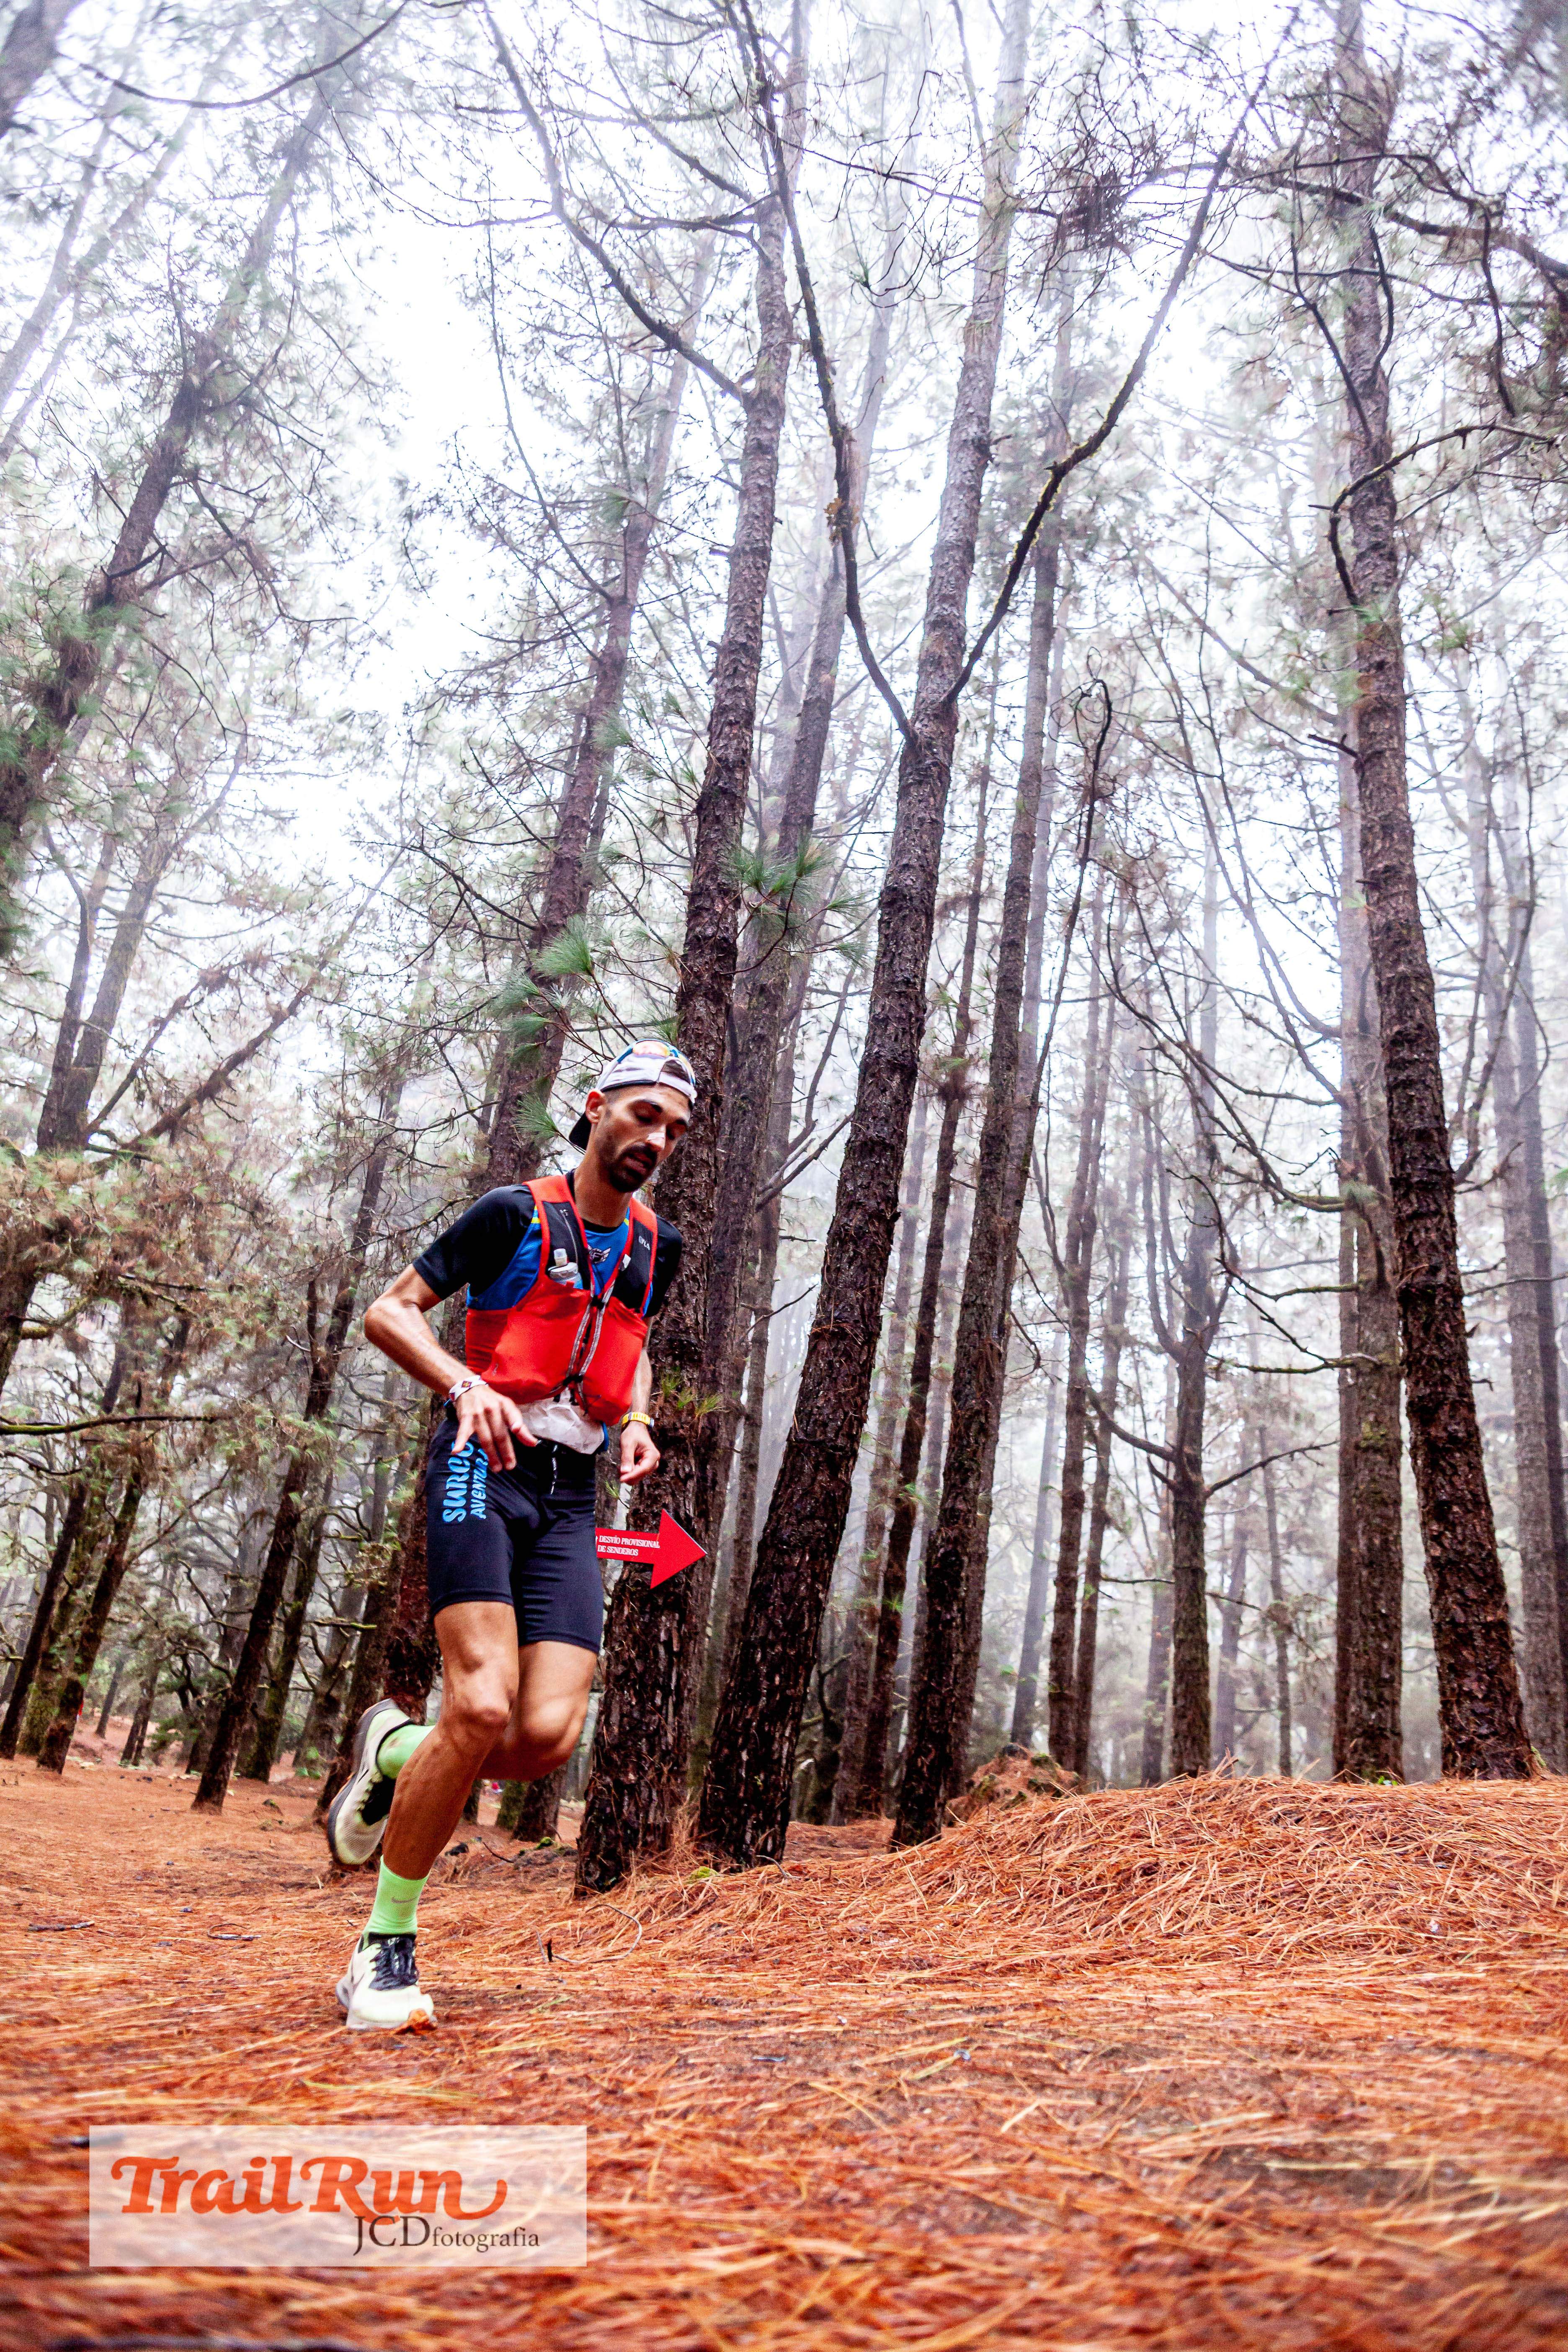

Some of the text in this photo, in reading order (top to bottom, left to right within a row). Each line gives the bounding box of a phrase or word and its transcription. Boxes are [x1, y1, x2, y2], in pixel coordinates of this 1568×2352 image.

[599, 1535, 660, 1548] DESVÍO PROVISIONAL
[607, 1546, 639, 1556] SENDEROS
